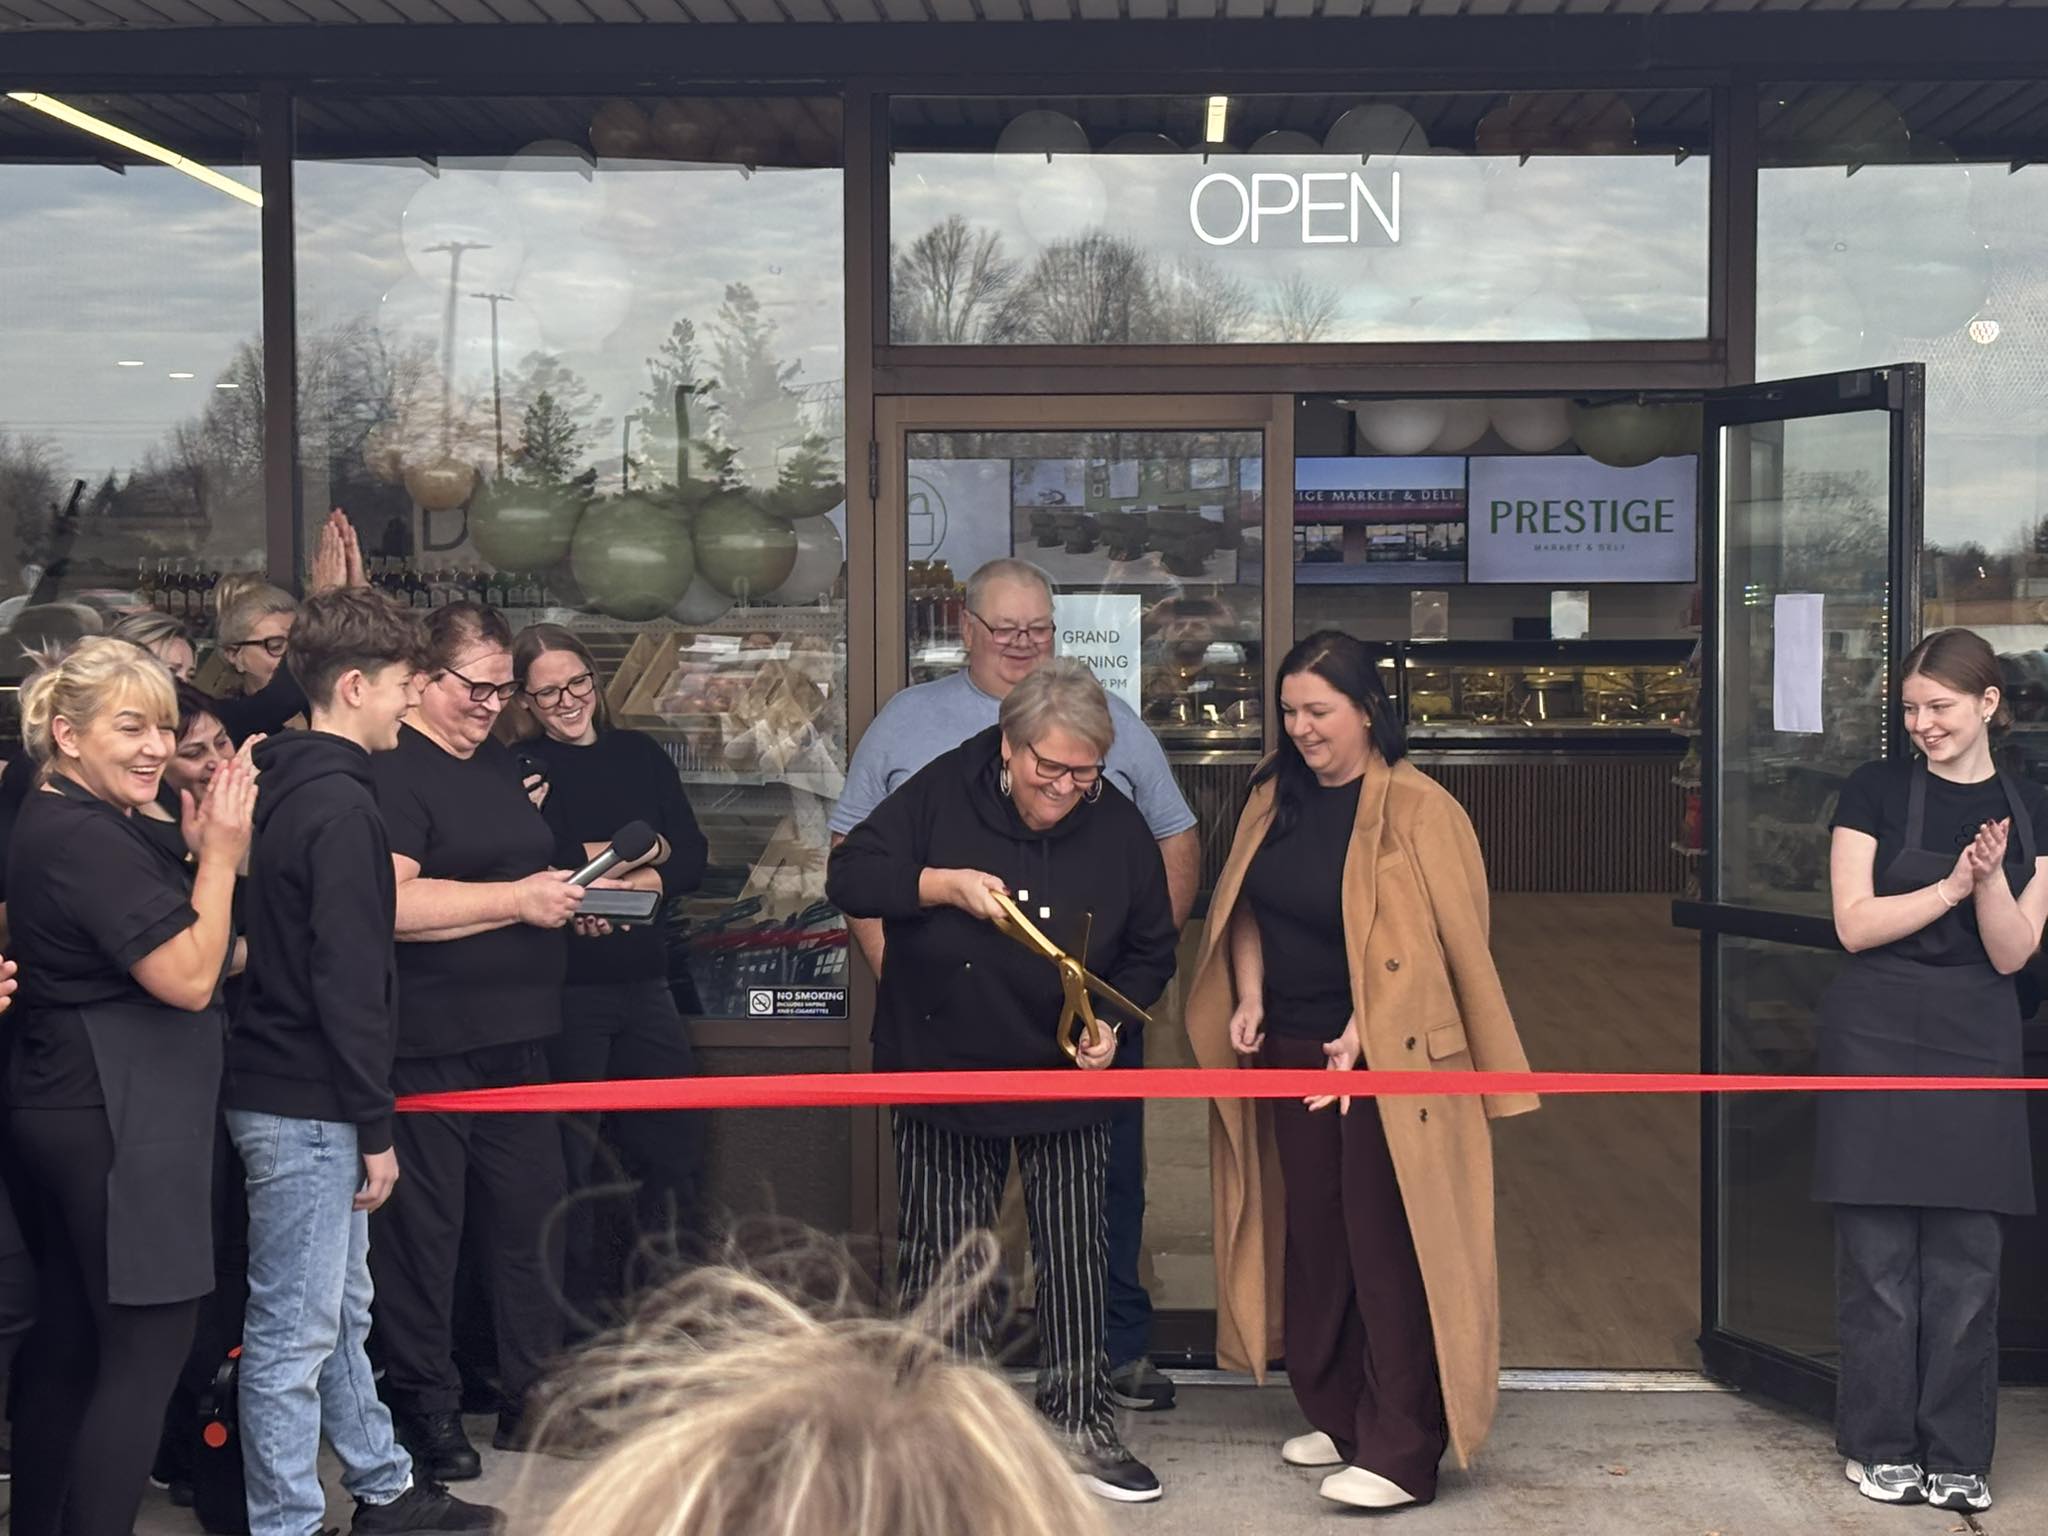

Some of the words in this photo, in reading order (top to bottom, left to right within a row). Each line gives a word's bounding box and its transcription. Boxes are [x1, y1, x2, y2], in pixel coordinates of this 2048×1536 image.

[1189, 171, 1401, 246] OPEN
[1332, 490, 1395, 502] MARKET
[1403, 490, 1417, 502] &
[1421, 489, 1455, 501] DELI
[1490, 499, 1676, 534] PRESTIGE
[1062, 630, 1120, 644] GRAND
[1110, 679, 1127, 689] PM
[777, 991, 793, 1001] NO
[794, 991, 844, 1001] SMOKING
